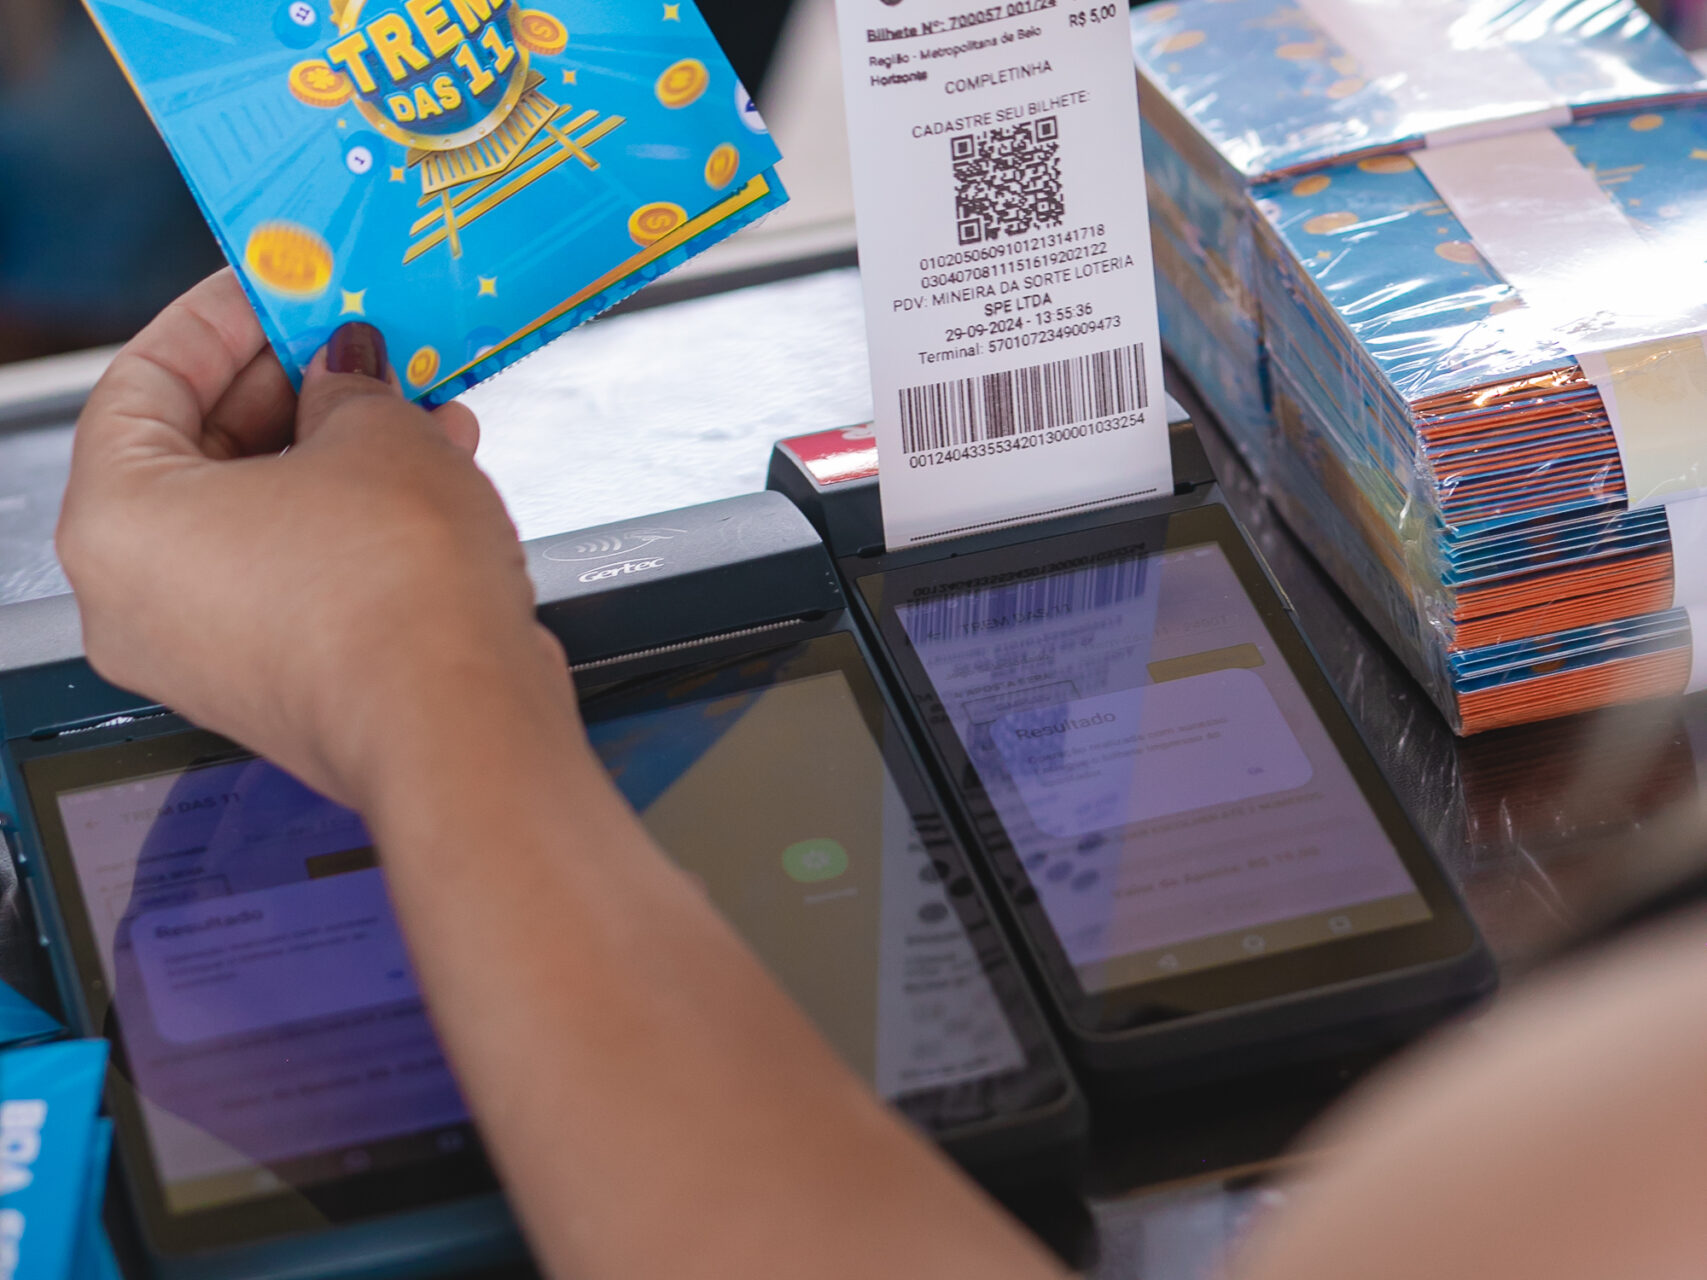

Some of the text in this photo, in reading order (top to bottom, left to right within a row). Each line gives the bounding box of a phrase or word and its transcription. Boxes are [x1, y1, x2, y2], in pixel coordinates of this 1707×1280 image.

[1068, 3, 1117, 27] R$ 5,00
[867, 26, 918, 43] Bilhete
[869, 53, 910, 68] Região
[920, 37, 998, 62] Metropolitana
[1000, 31, 1014, 44] de
[387, 25, 515, 123] DAS 11
[870, 70, 928, 87] Horizonte
[944, 60, 1053, 95] COMPLETINHA
[912, 90, 1091, 139] CADASTRE SEU BILHETE:
[920, 224, 1106, 271] 0102050609101213141718
[921, 242, 1108, 289] 0304070811151619202122
[893, 254, 1135, 313] PDV: MINEIRA DA SORTE LOTERIA
[945, 316, 1024, 342] 29-09-2024
[1036, 302, 1094, 325] 13:55:36
[984, 293, 1053, 317] SPE LTDA
[918, 315, 1122, 365] Terminal: 5701072349009473
[578, 557, 665, 583] Gertec
[1015, 711, 1116, 741] Resultado
